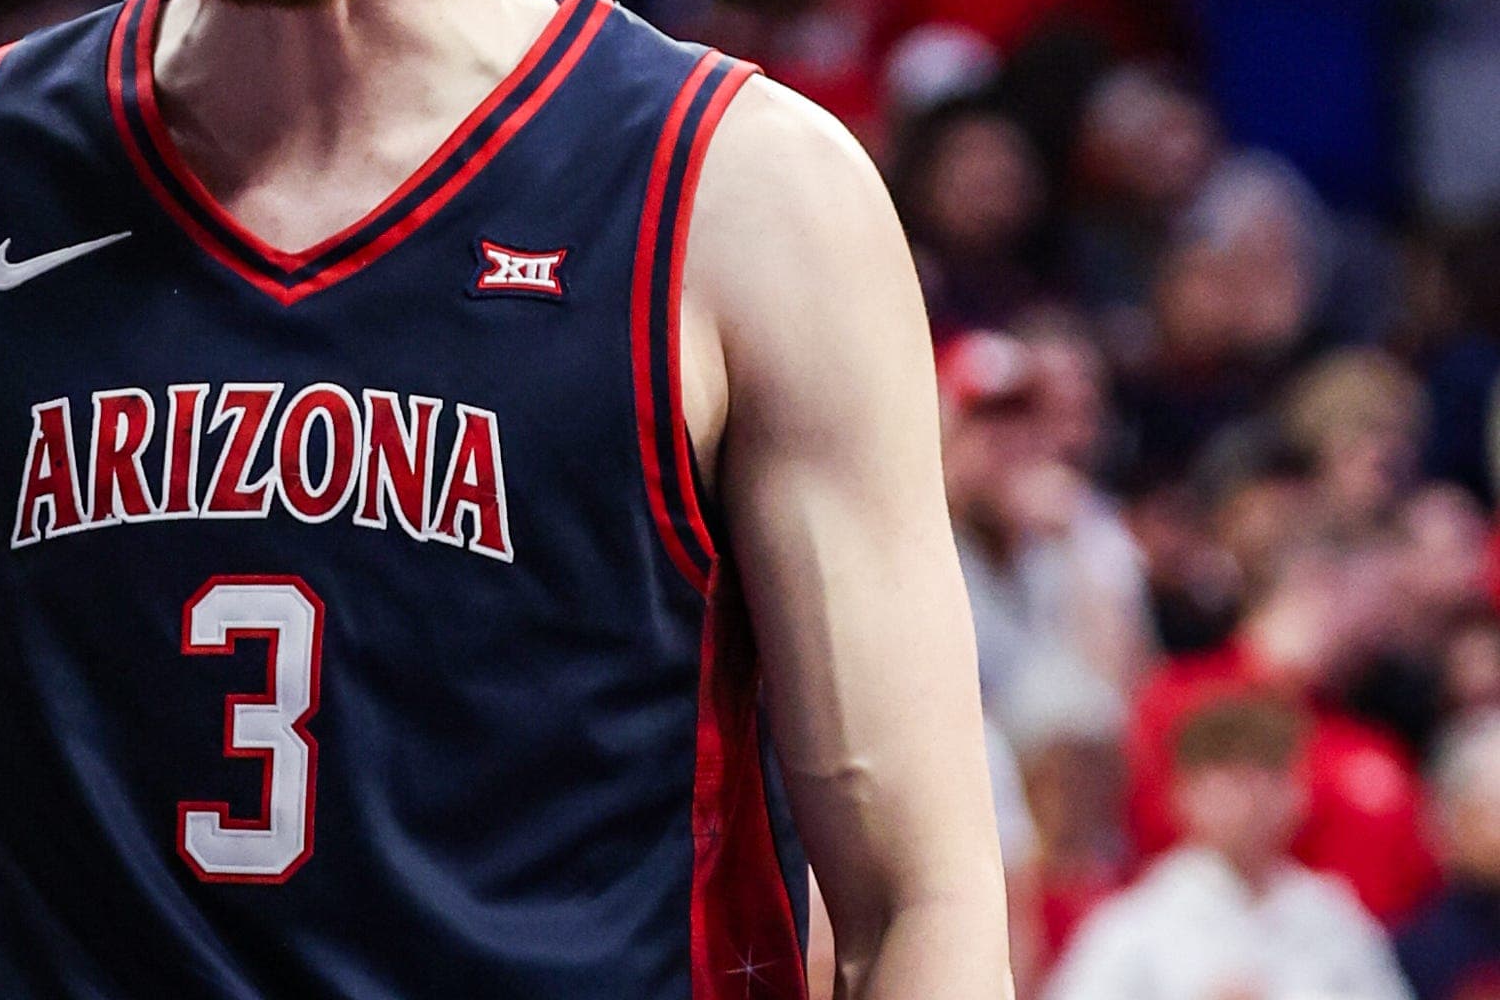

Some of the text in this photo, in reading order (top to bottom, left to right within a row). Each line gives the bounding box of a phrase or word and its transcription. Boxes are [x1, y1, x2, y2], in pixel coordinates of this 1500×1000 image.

[481, 246, 562, 290] XII
[11, 382, 514, 563] ARIZONA
[178, 575, 324, 883] 3
